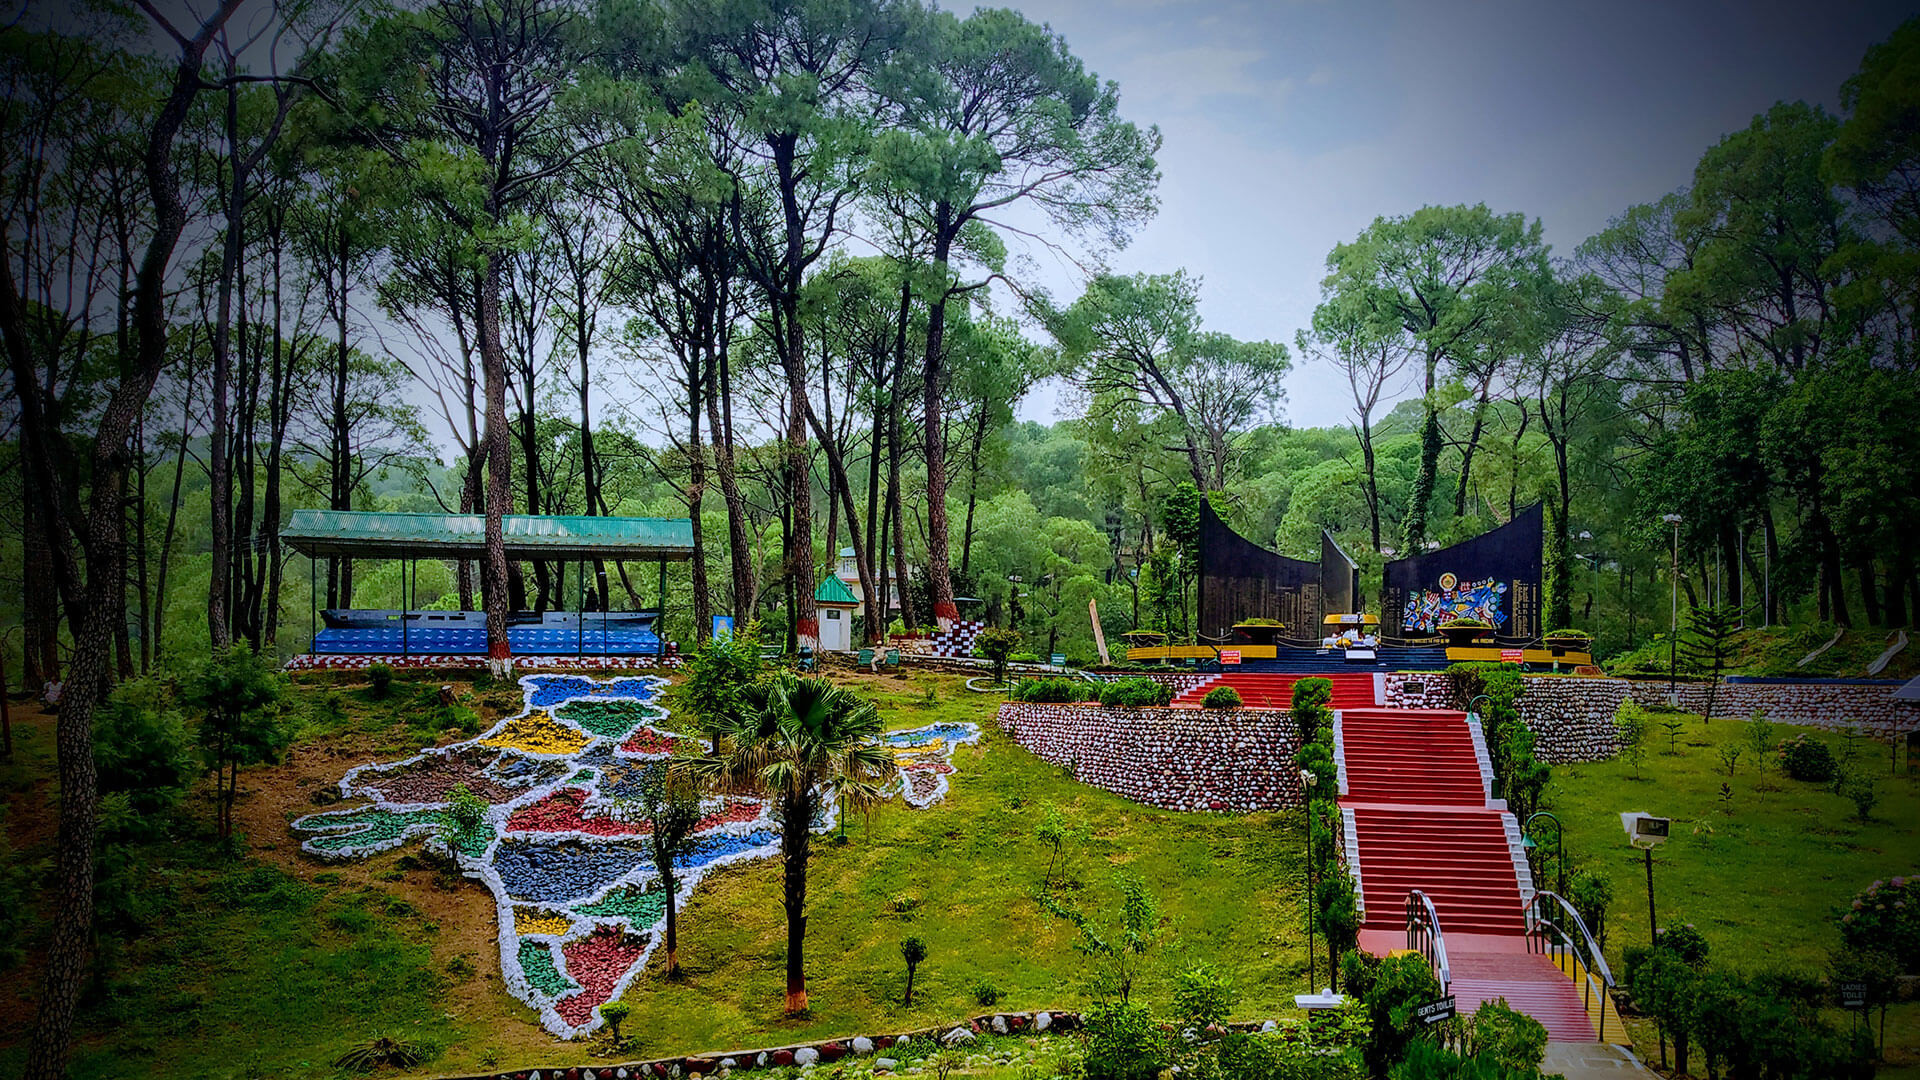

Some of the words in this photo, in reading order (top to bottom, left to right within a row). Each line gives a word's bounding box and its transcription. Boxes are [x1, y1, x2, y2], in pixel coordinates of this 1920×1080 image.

[1841, 983, 1867, 991] LADIES
[1842, 991, 1866, 999] TOILET
[1417, 1003, 1436, 1016] GENTS
[1436, 999, 1455, 1011] TOILET
